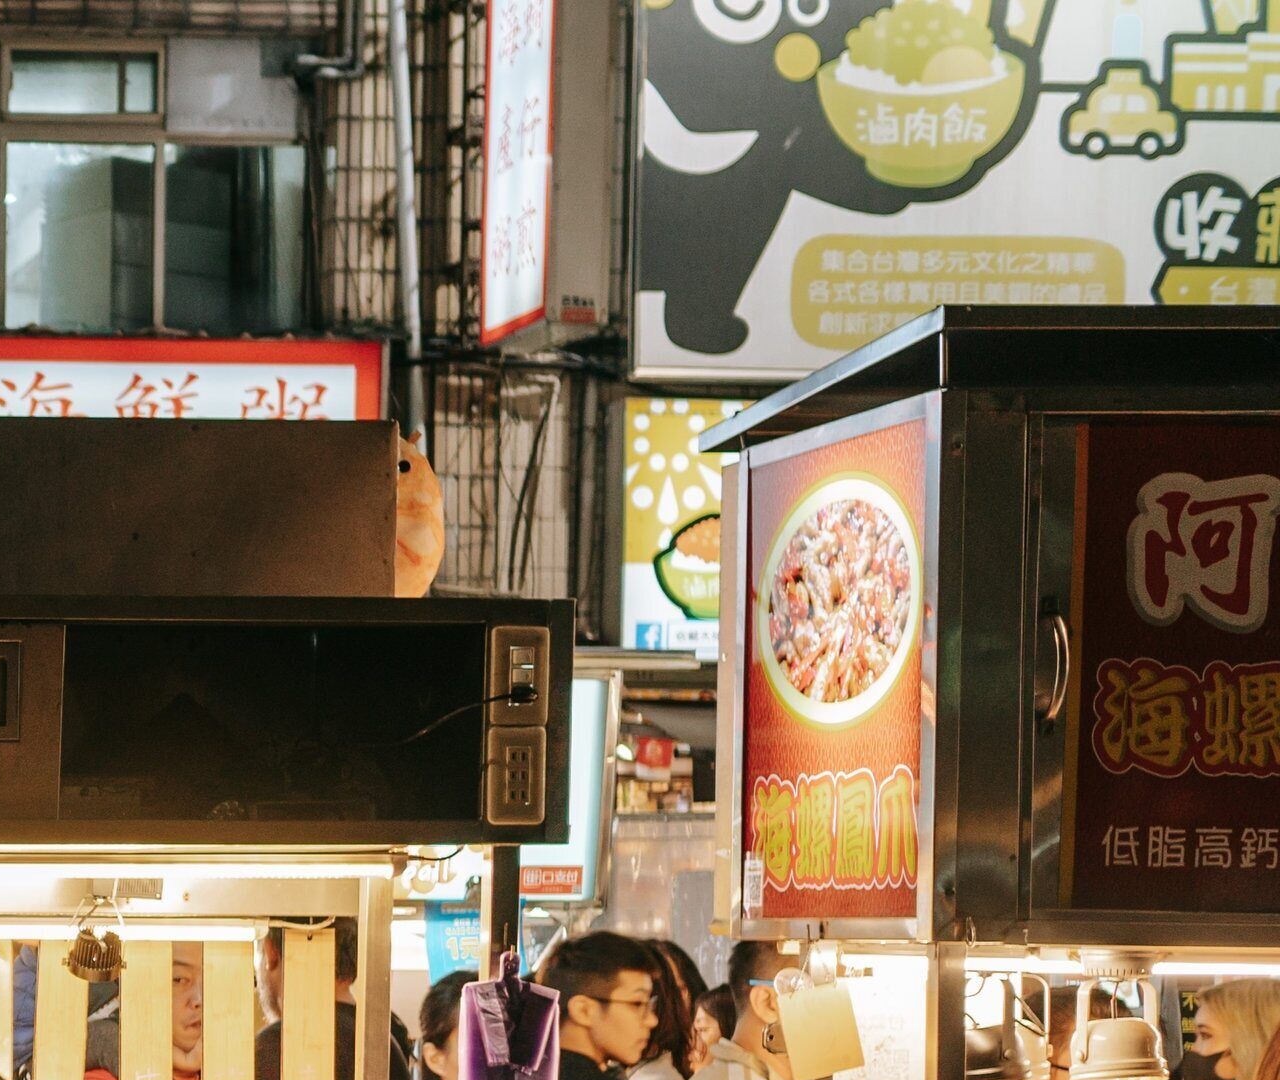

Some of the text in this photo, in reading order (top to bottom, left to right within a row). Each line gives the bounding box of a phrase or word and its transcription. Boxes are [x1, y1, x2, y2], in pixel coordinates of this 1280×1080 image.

[856, 102, 987, 149] 滷肉飯
[1164, 184, 1280, 264] 收
[1130, 473, 1277, 630] 阿
[755, 772, 920, 886] 海螺鳳爪
[1101, 823, 1280, 870] 低脂高鈣
